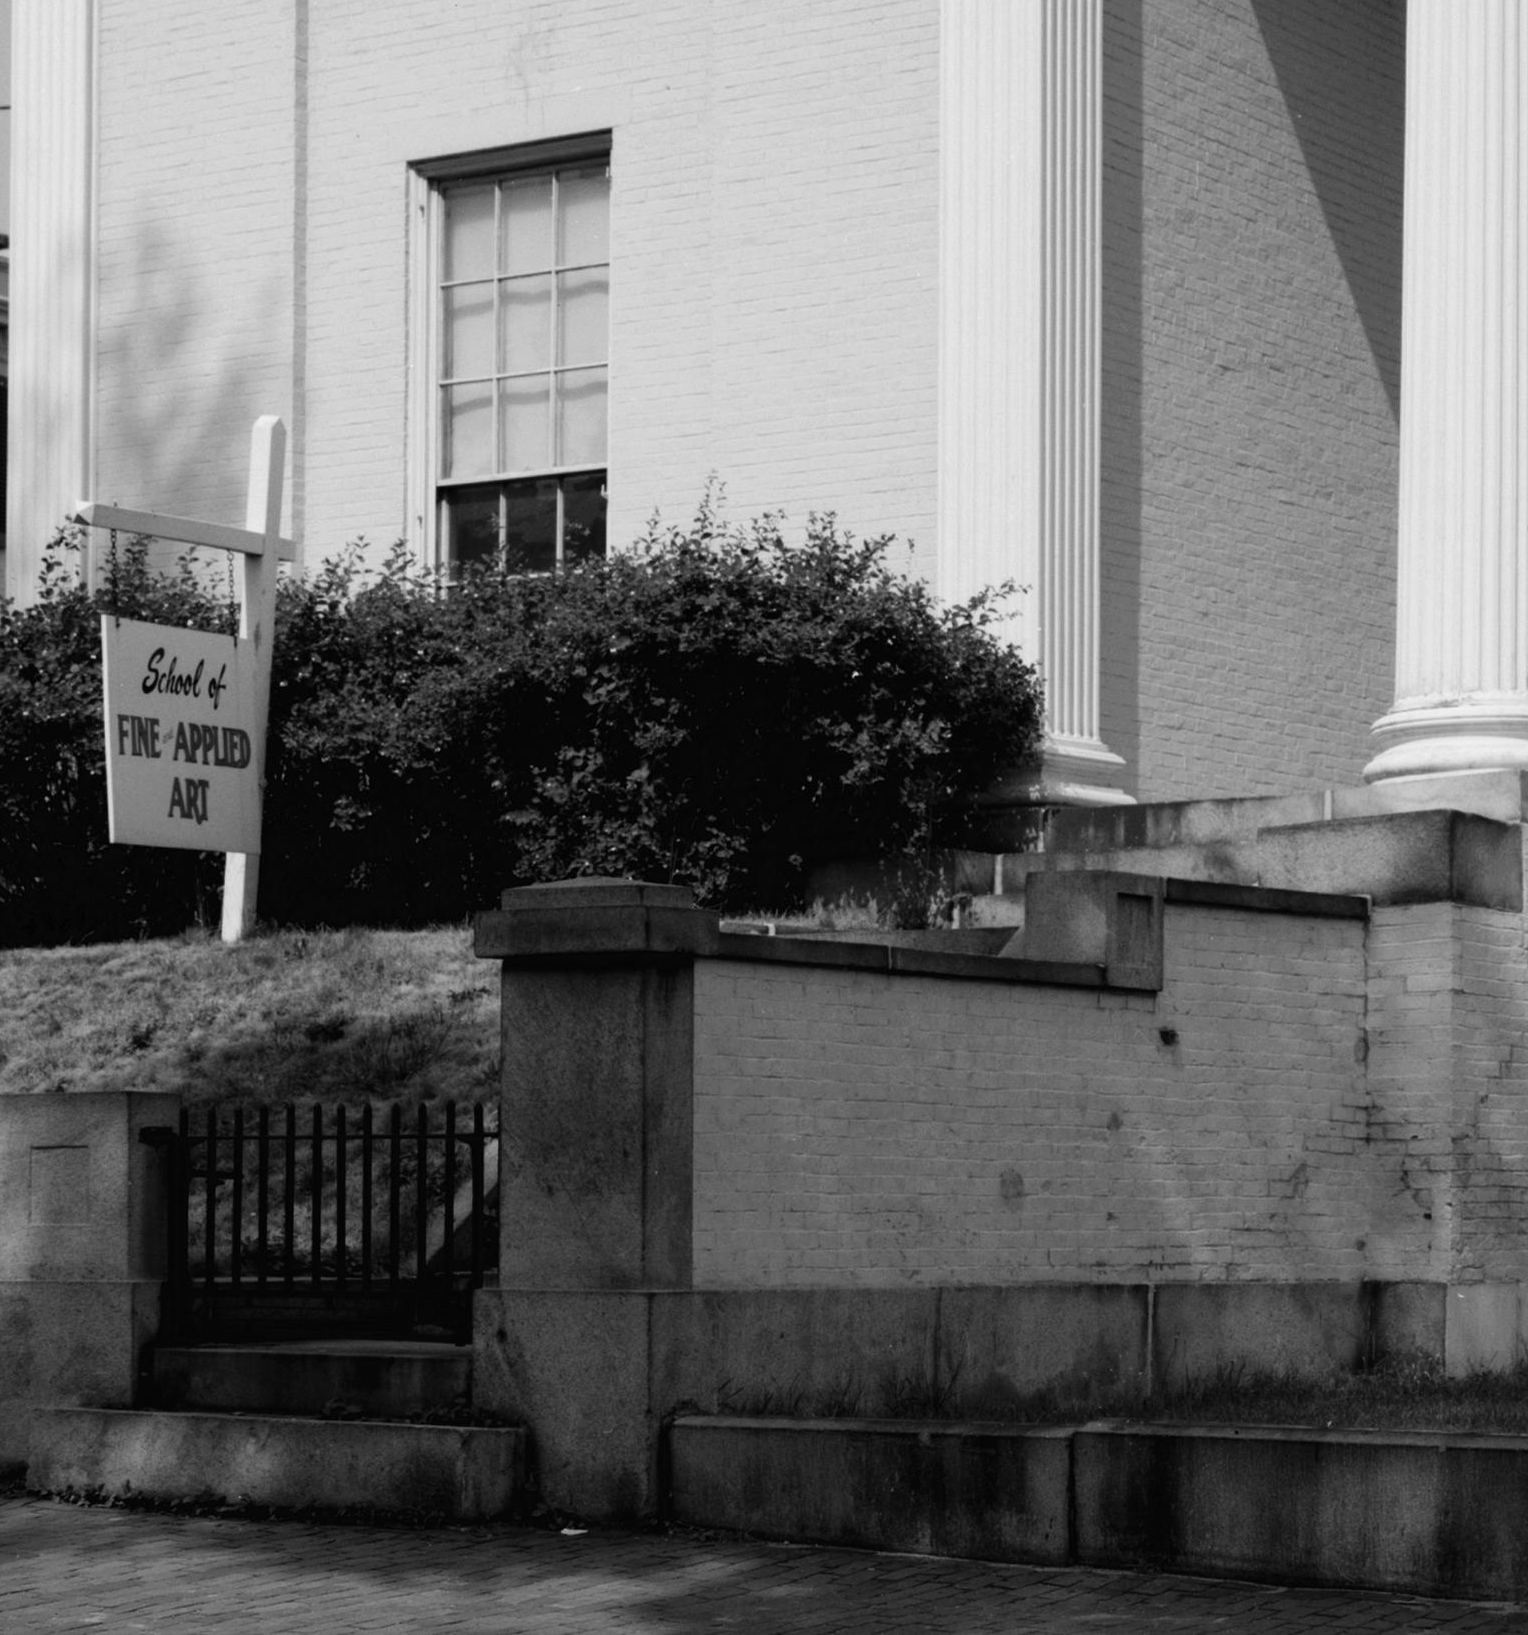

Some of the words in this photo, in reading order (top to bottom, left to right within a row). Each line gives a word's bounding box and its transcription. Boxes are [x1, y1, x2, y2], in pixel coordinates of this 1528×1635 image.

[142, 647, 204, 696] School
[208, 663, 227, 710] of
[117, 714, 161, 759] FINE
[173, 721, 251, 769] APPLIED
[168, 777, 210, 825] ART
